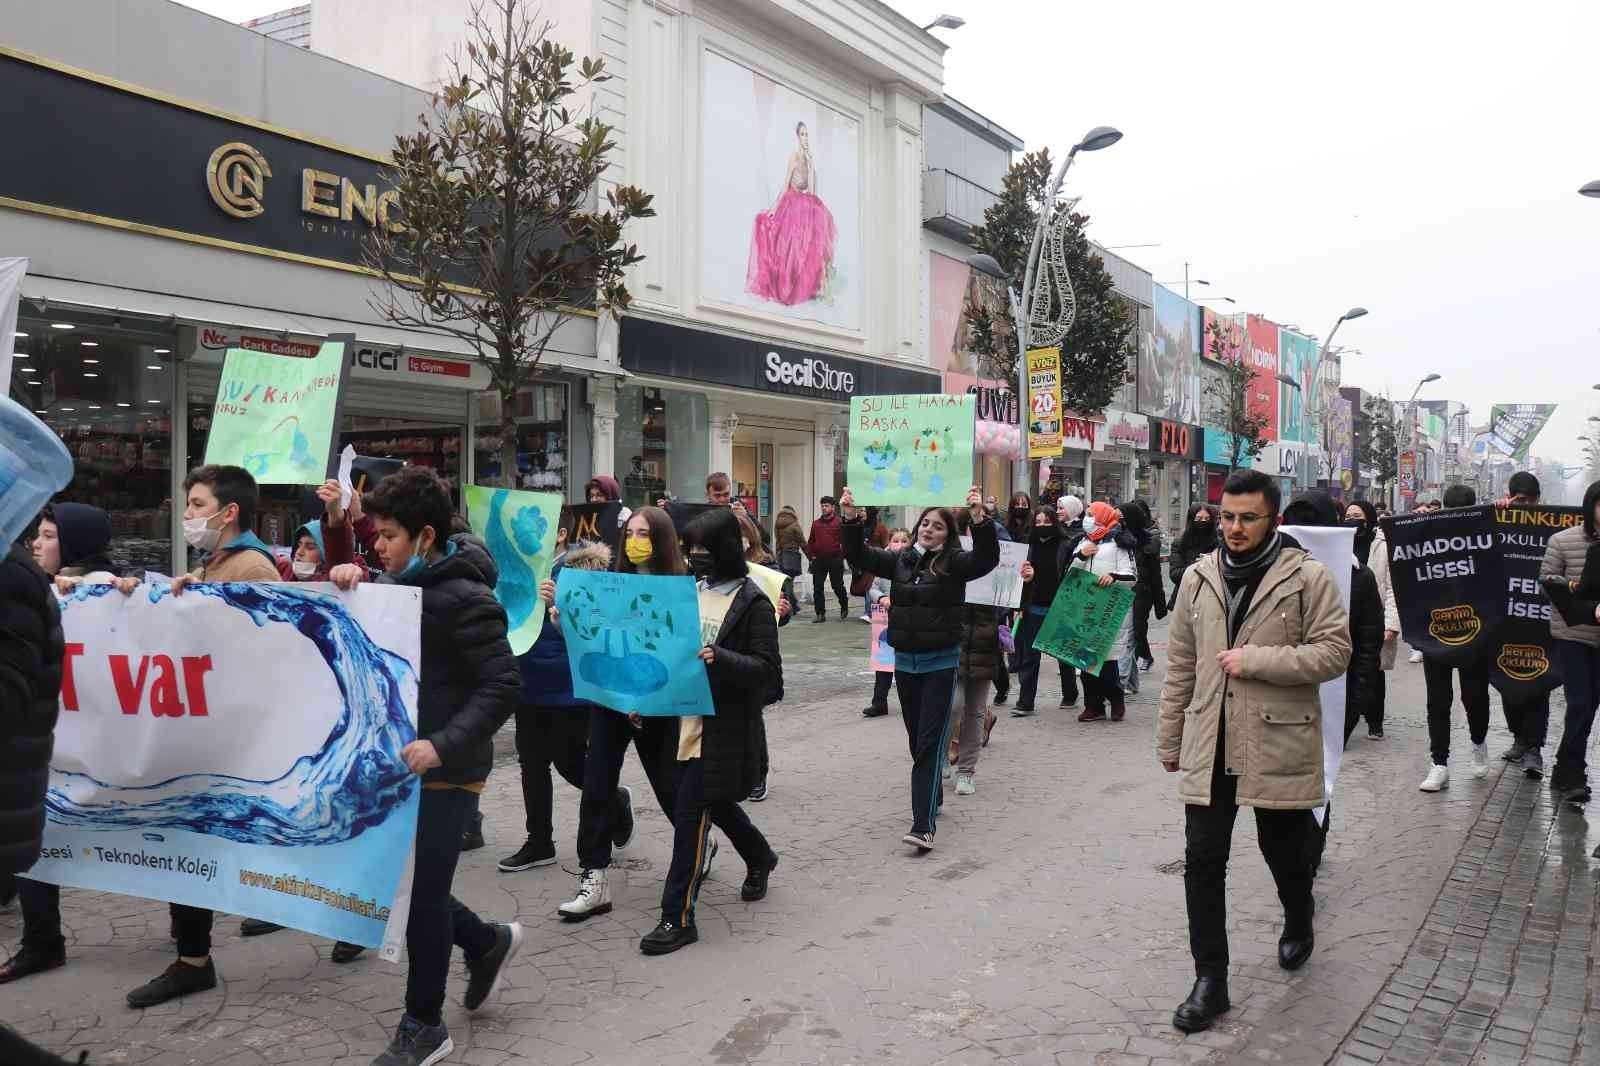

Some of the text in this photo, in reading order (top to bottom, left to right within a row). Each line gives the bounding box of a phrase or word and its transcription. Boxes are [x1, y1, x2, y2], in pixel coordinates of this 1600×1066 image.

[302, 168, 403, 233] ENC
[765, 352, 854, 393] SecilStore
[860, 398, 883, 413] SU
[1034, 393, 1053, 412] 20
[1161, 420, 1189, 456] FLO
[1393, 534, 1493, 562] ANADOLU
[1415, 555, 1476, 581] LİSESİ
[108, 653, 212, 718] var
[94, 846, 174, 872] Teknokent
[177, 855, 218, 882] Koleji
